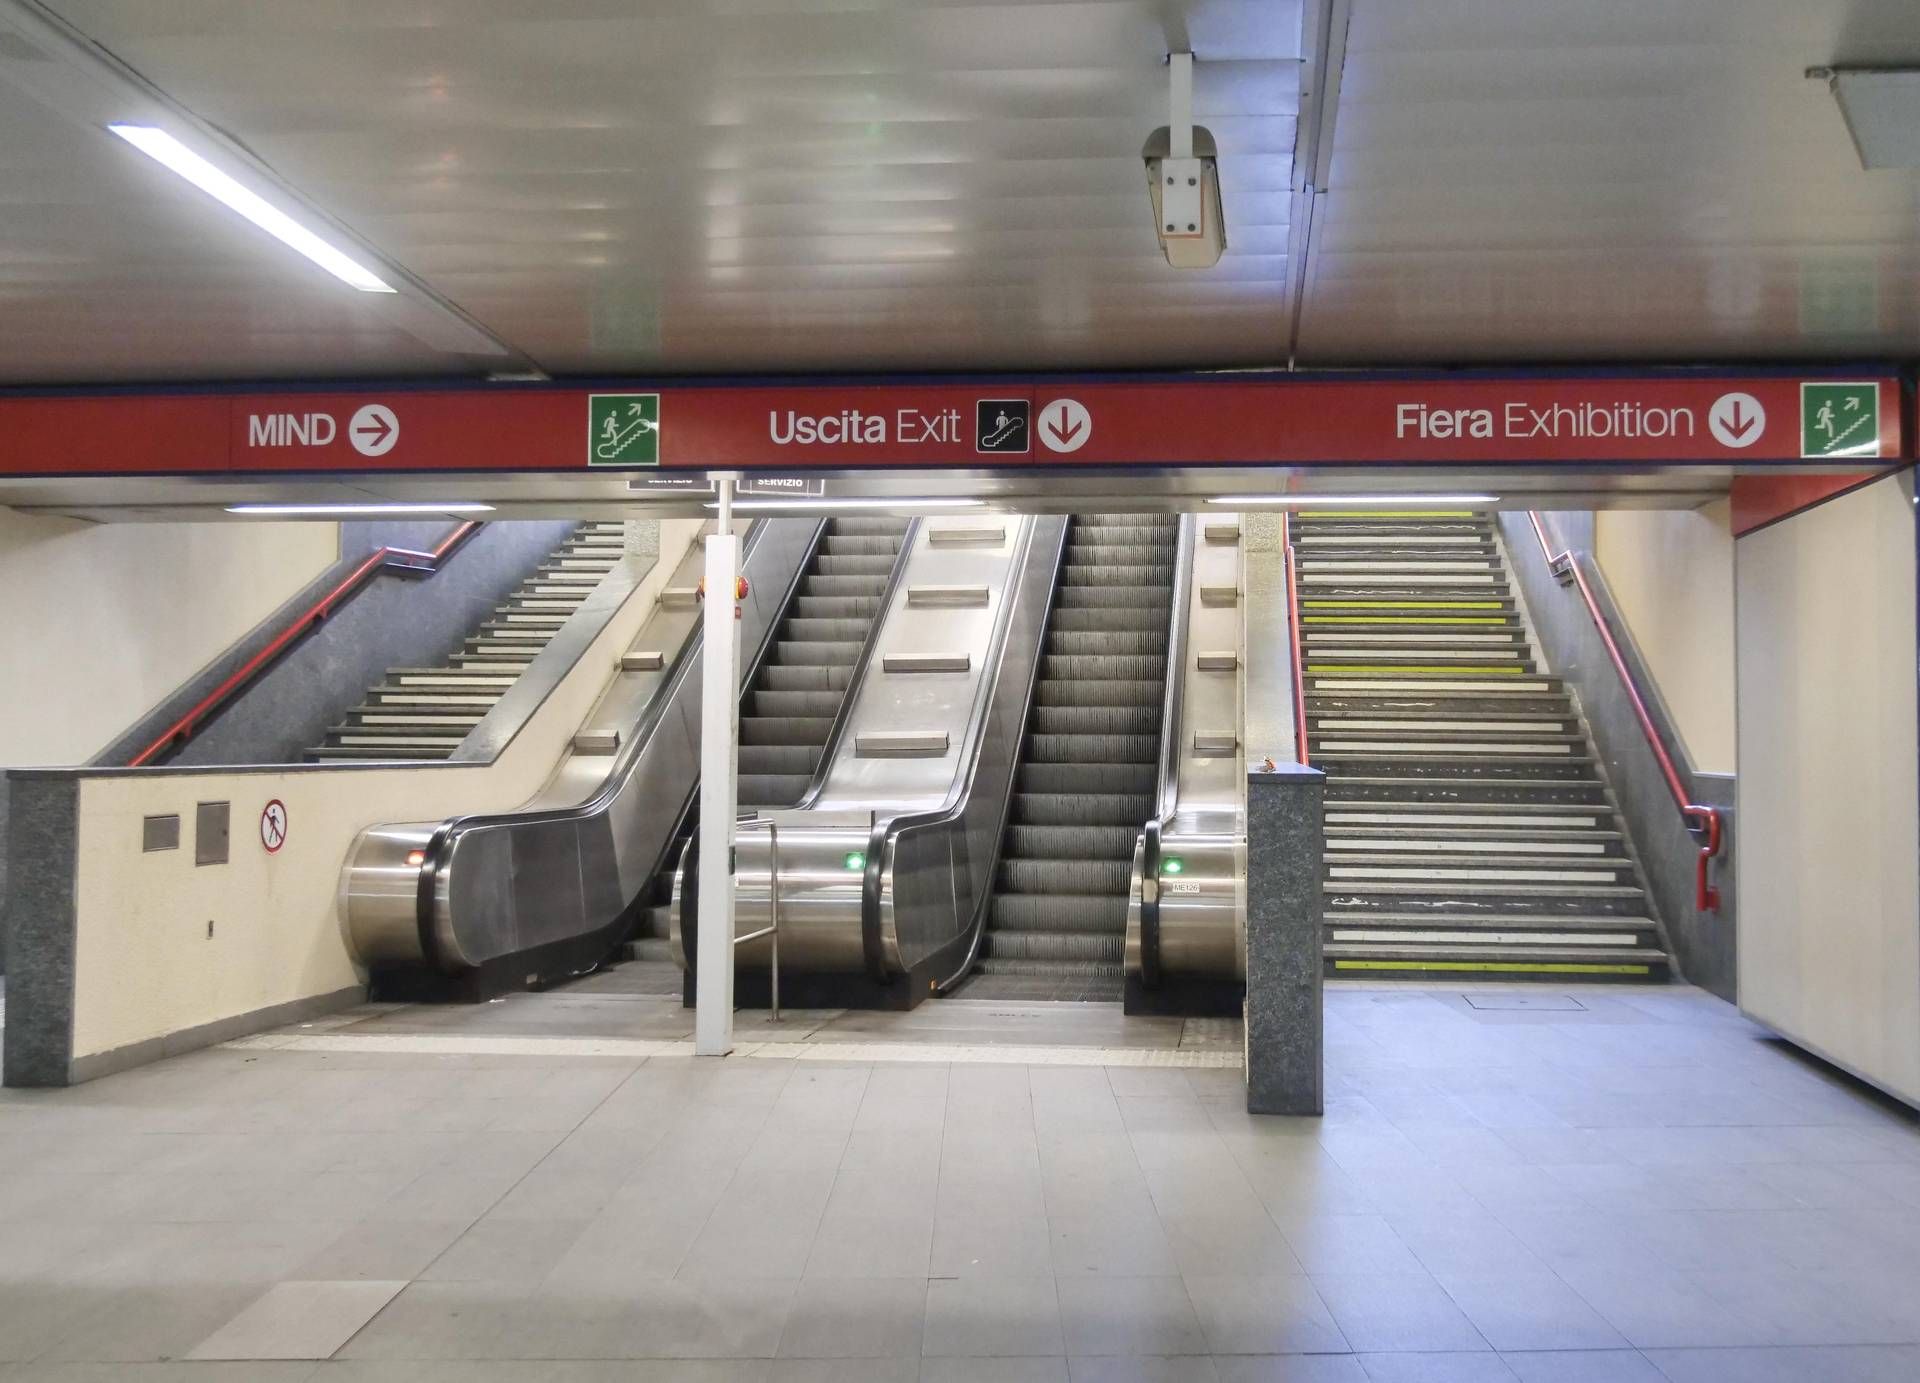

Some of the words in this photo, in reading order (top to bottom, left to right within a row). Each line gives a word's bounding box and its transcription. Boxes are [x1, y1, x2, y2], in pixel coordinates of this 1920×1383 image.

[249, 413, 336, 447] MIND
[770, 409, 887, 444] Uscita
[897, 409, 961, 443] Exit
[1397, 403, 1493, 438] Fiera
[1505, 402, 1694, 437] Exhibition
[757, 478, 803, 487] SERVIZIO
